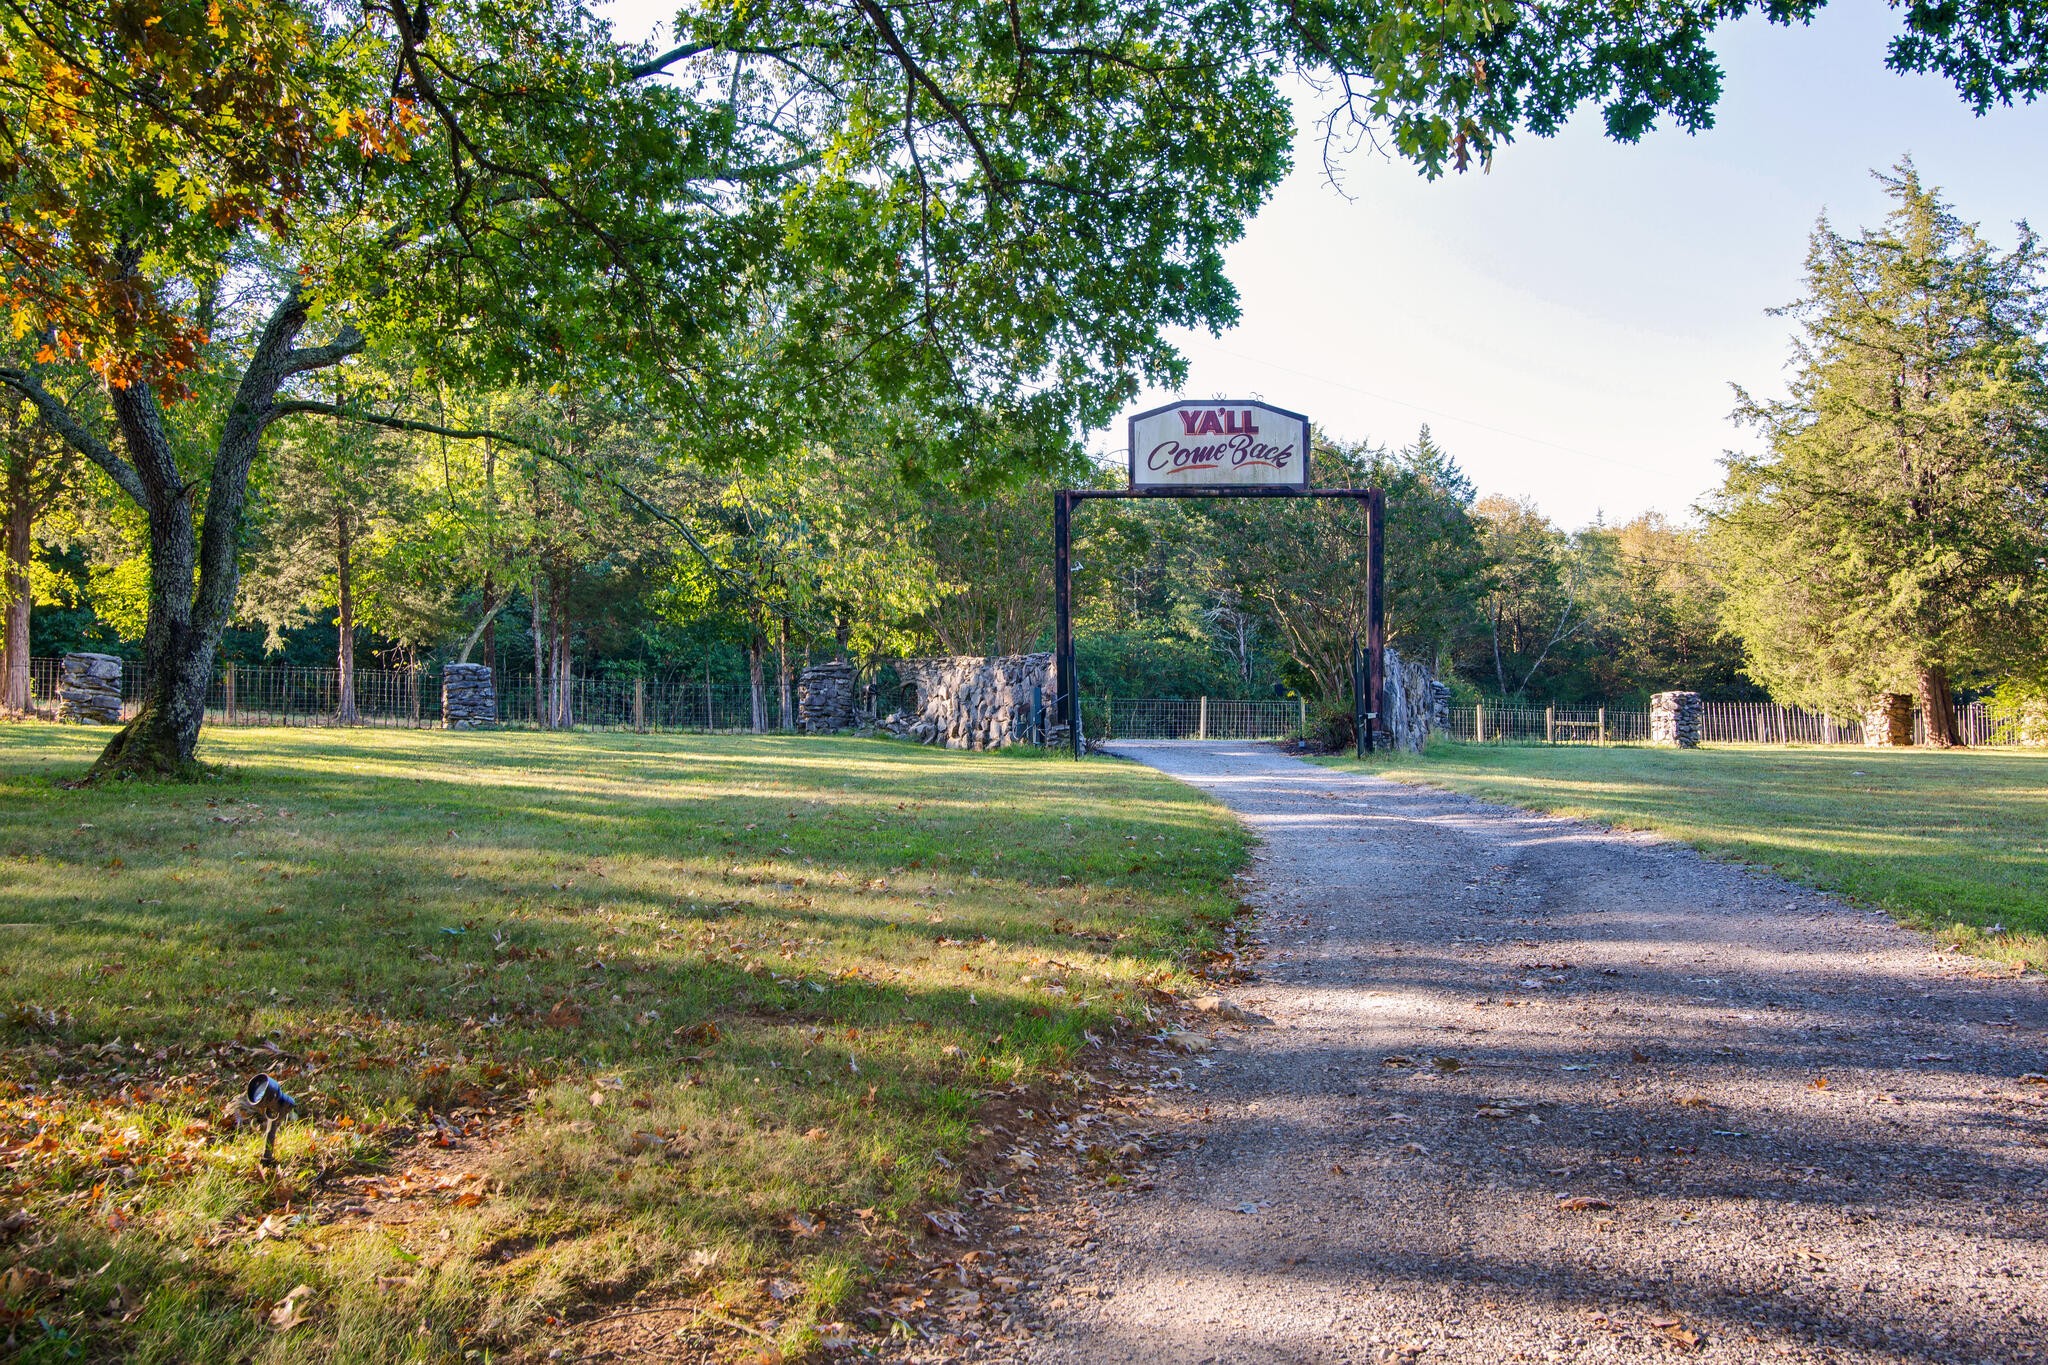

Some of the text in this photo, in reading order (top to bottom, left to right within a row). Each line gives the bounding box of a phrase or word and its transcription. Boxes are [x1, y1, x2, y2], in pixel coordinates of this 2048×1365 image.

[1178, 407, 1259, 436] YA'LL
[1147, 434, 1294, 471] Come Back
